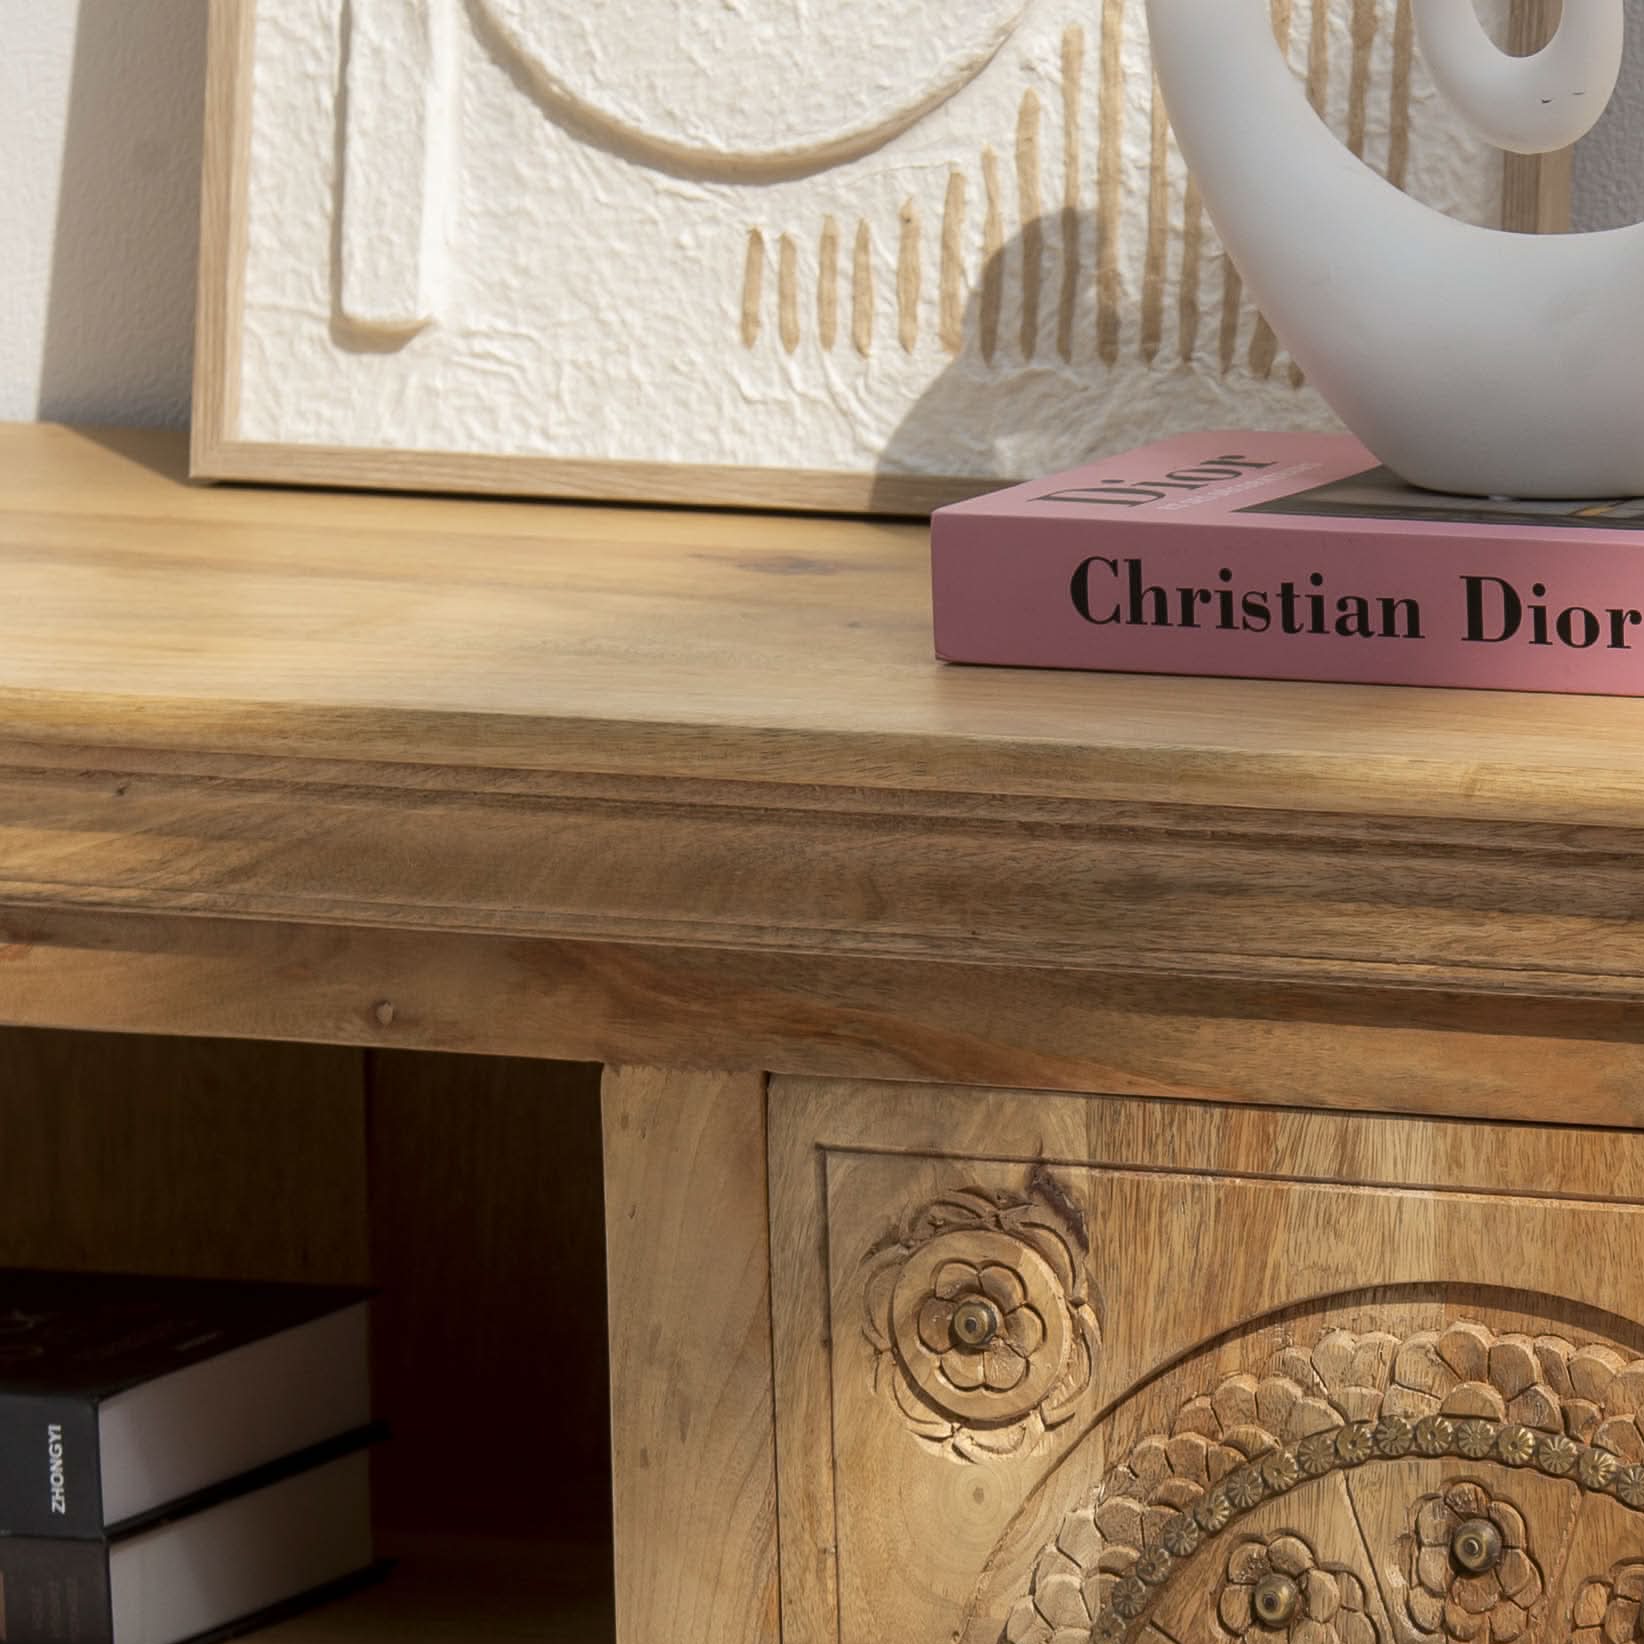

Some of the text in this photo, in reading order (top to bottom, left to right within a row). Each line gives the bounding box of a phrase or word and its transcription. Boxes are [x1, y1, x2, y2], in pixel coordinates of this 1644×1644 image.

[1026, 455, 1279, 508] Dior
[1069, 555, 1643, 650] Christian Dior
[47, 1423, 66, 1515] ZHONGYI
